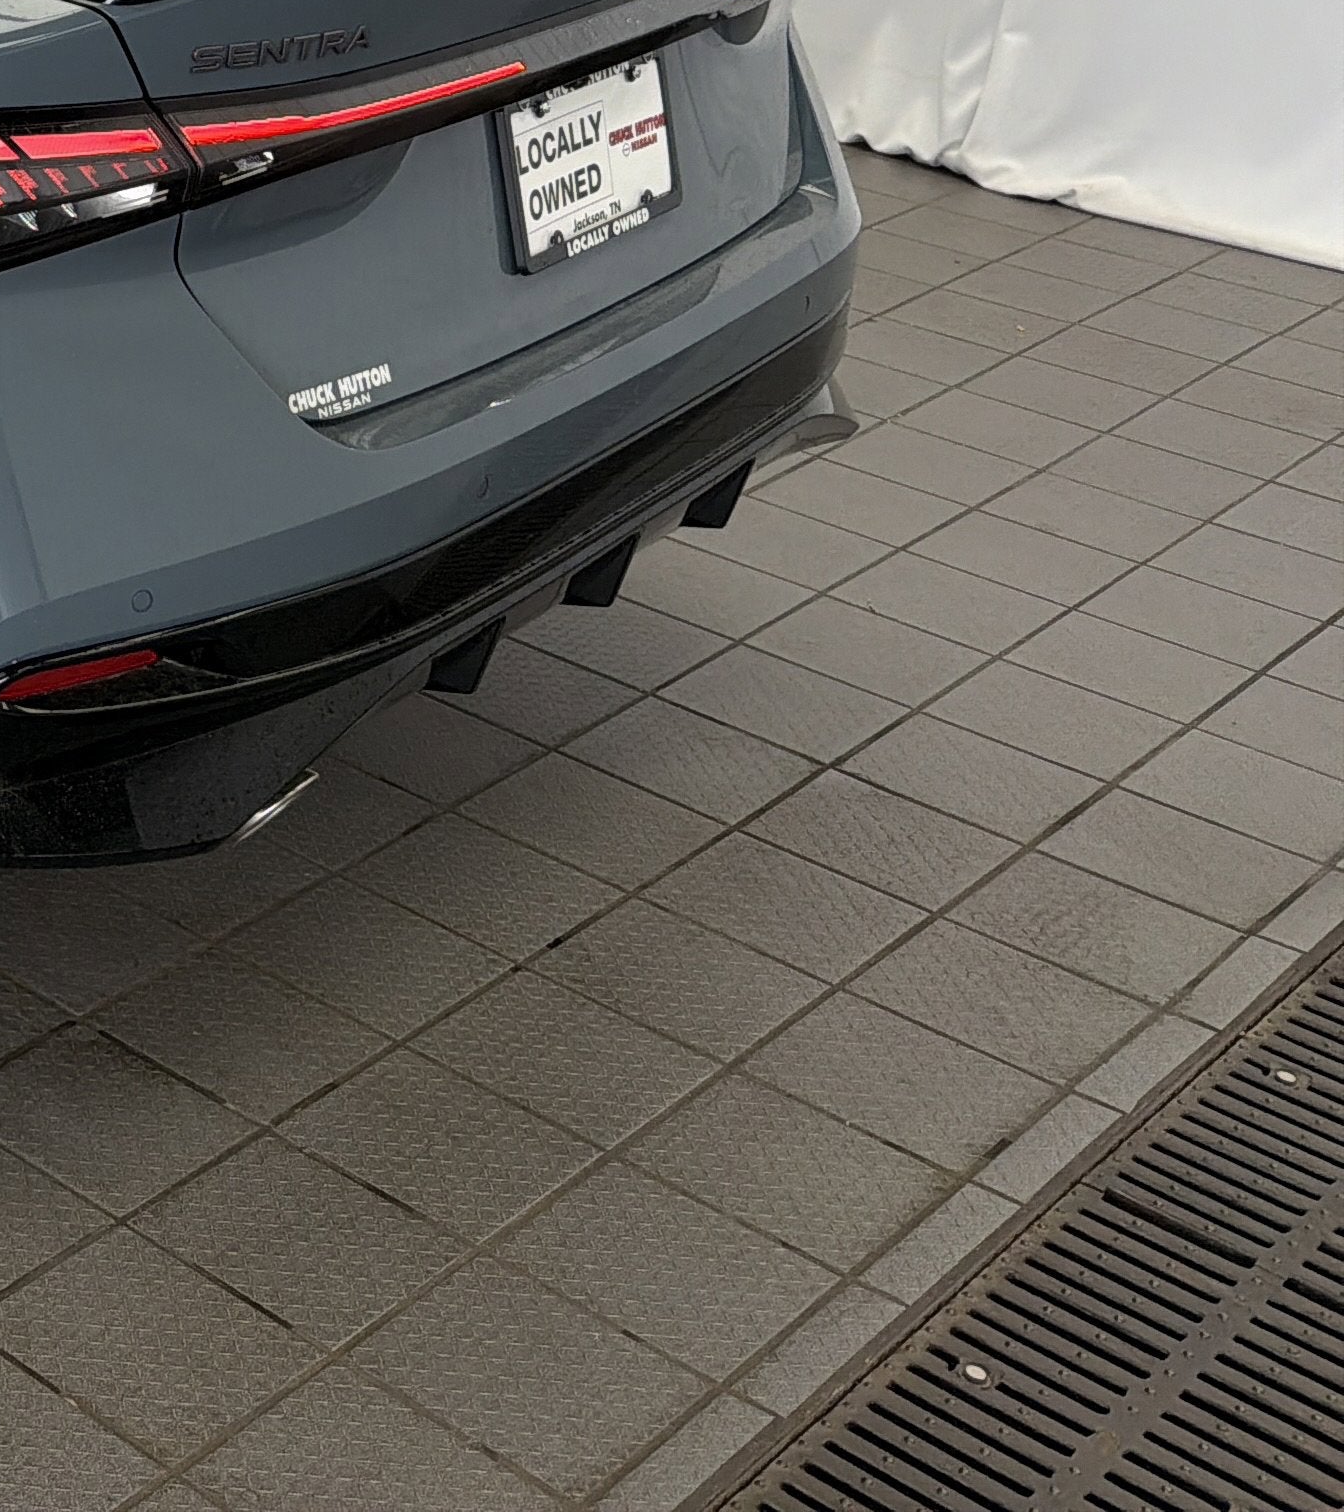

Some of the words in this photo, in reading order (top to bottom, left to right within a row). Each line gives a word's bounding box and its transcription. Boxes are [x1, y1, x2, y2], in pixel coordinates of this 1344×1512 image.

[191, 24, 369, 74] SENTRA
[515, 110, 602, 176] LOCALLY
[608, 124, 634, 146] CHUCK
[634, 112, 668, 137] HUTTON
[631, 133, 657, 152] NISSAN
[529, 163, 602, 221] OWNED
[573, 210, 608, 233] Jackson,
[609, 199, 622, 215] TN
[566, 224, 609, 257] LOCALLY
[612, 207, 650, 236] OWNED
[288, 381, 337, 414] CHUCK
[336, 363, 392, 399] HUTTON
[317, 392, 372, 419] NISSAN
